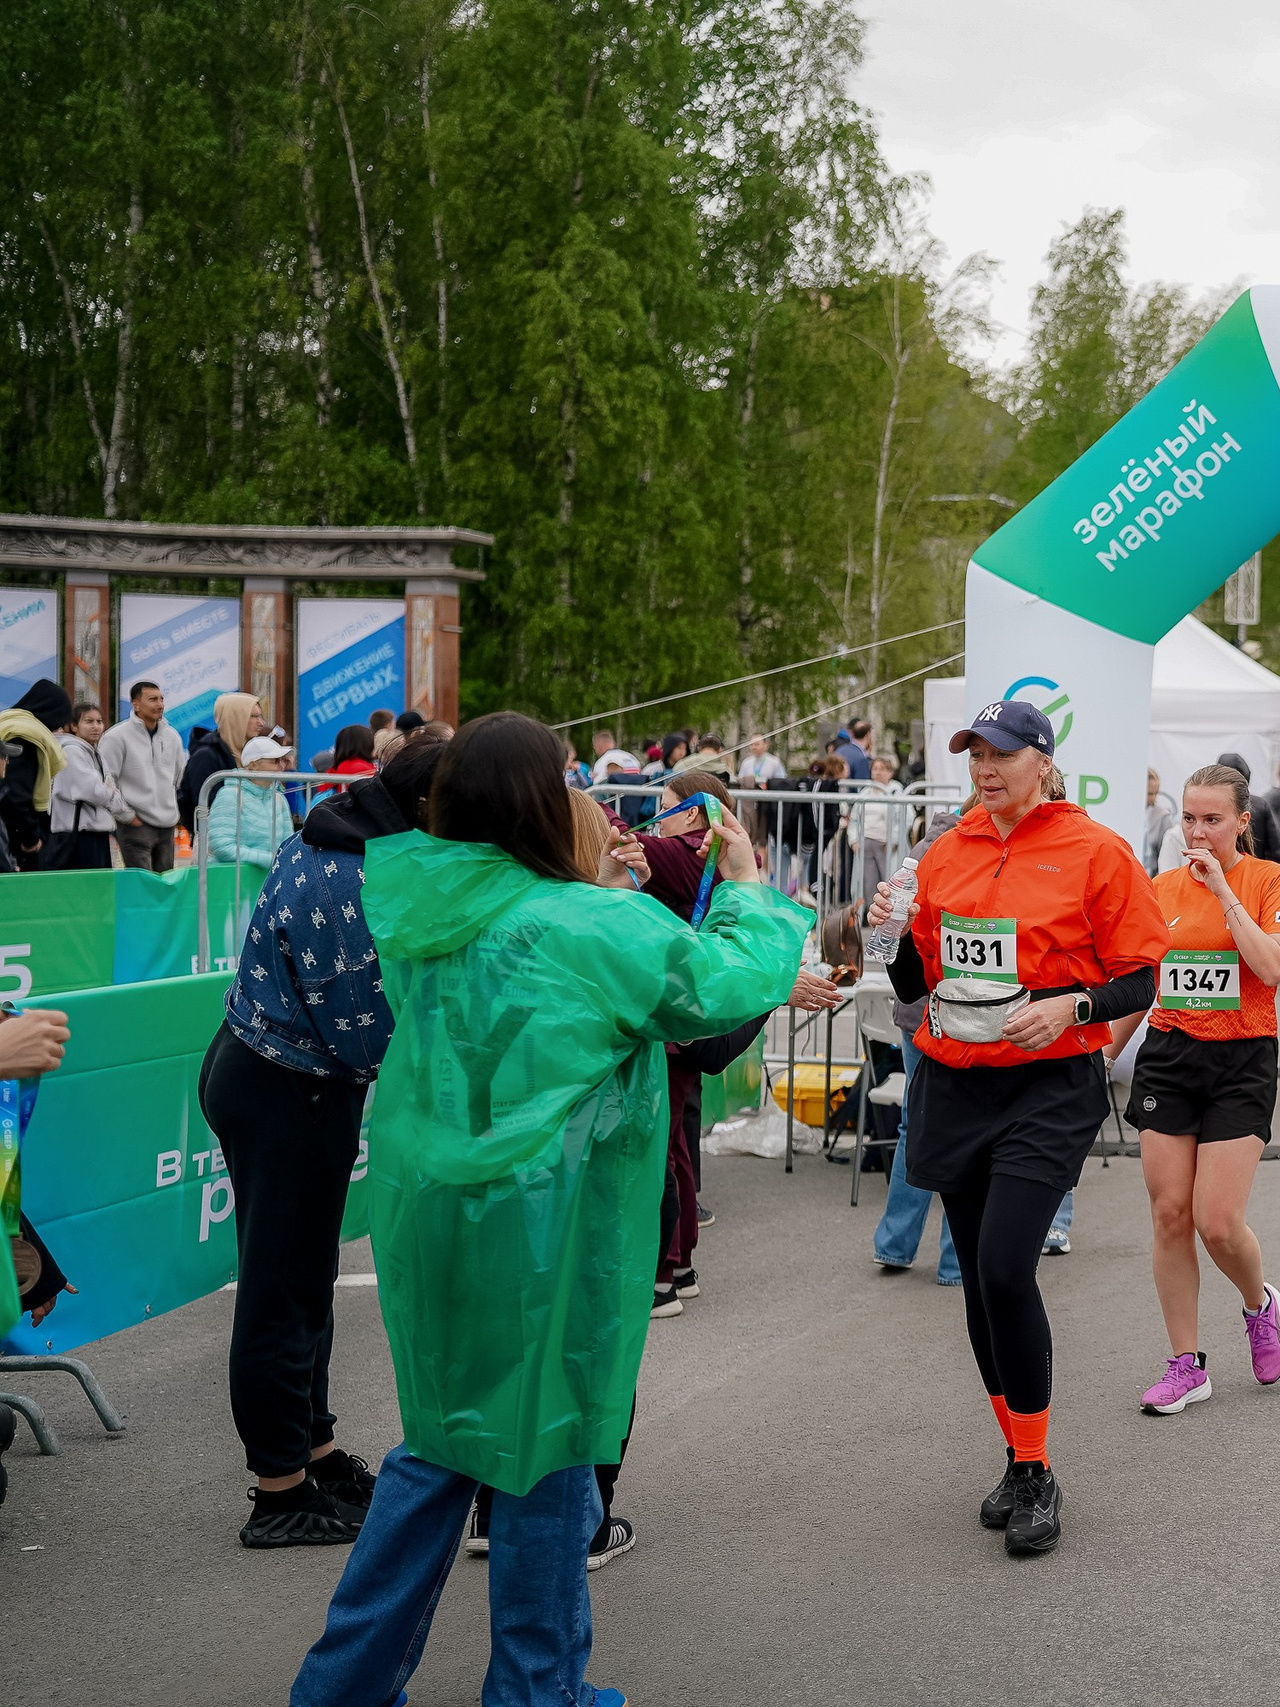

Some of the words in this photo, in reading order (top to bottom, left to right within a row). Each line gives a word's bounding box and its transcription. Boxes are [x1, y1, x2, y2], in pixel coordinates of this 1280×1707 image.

[1072, 398, 1217, 545] зелёный
[1095, 431, 1242, 573] марафон
[306, 662, 401, 730] ПЕРВЫХ
[311, 640, 397, 704] ДВИЖЕНИЕ
[946, 934, 1003, 967] 1331
[1168, 968, 1230, 991] 1347
[156, 1149, 182, 1188] В
